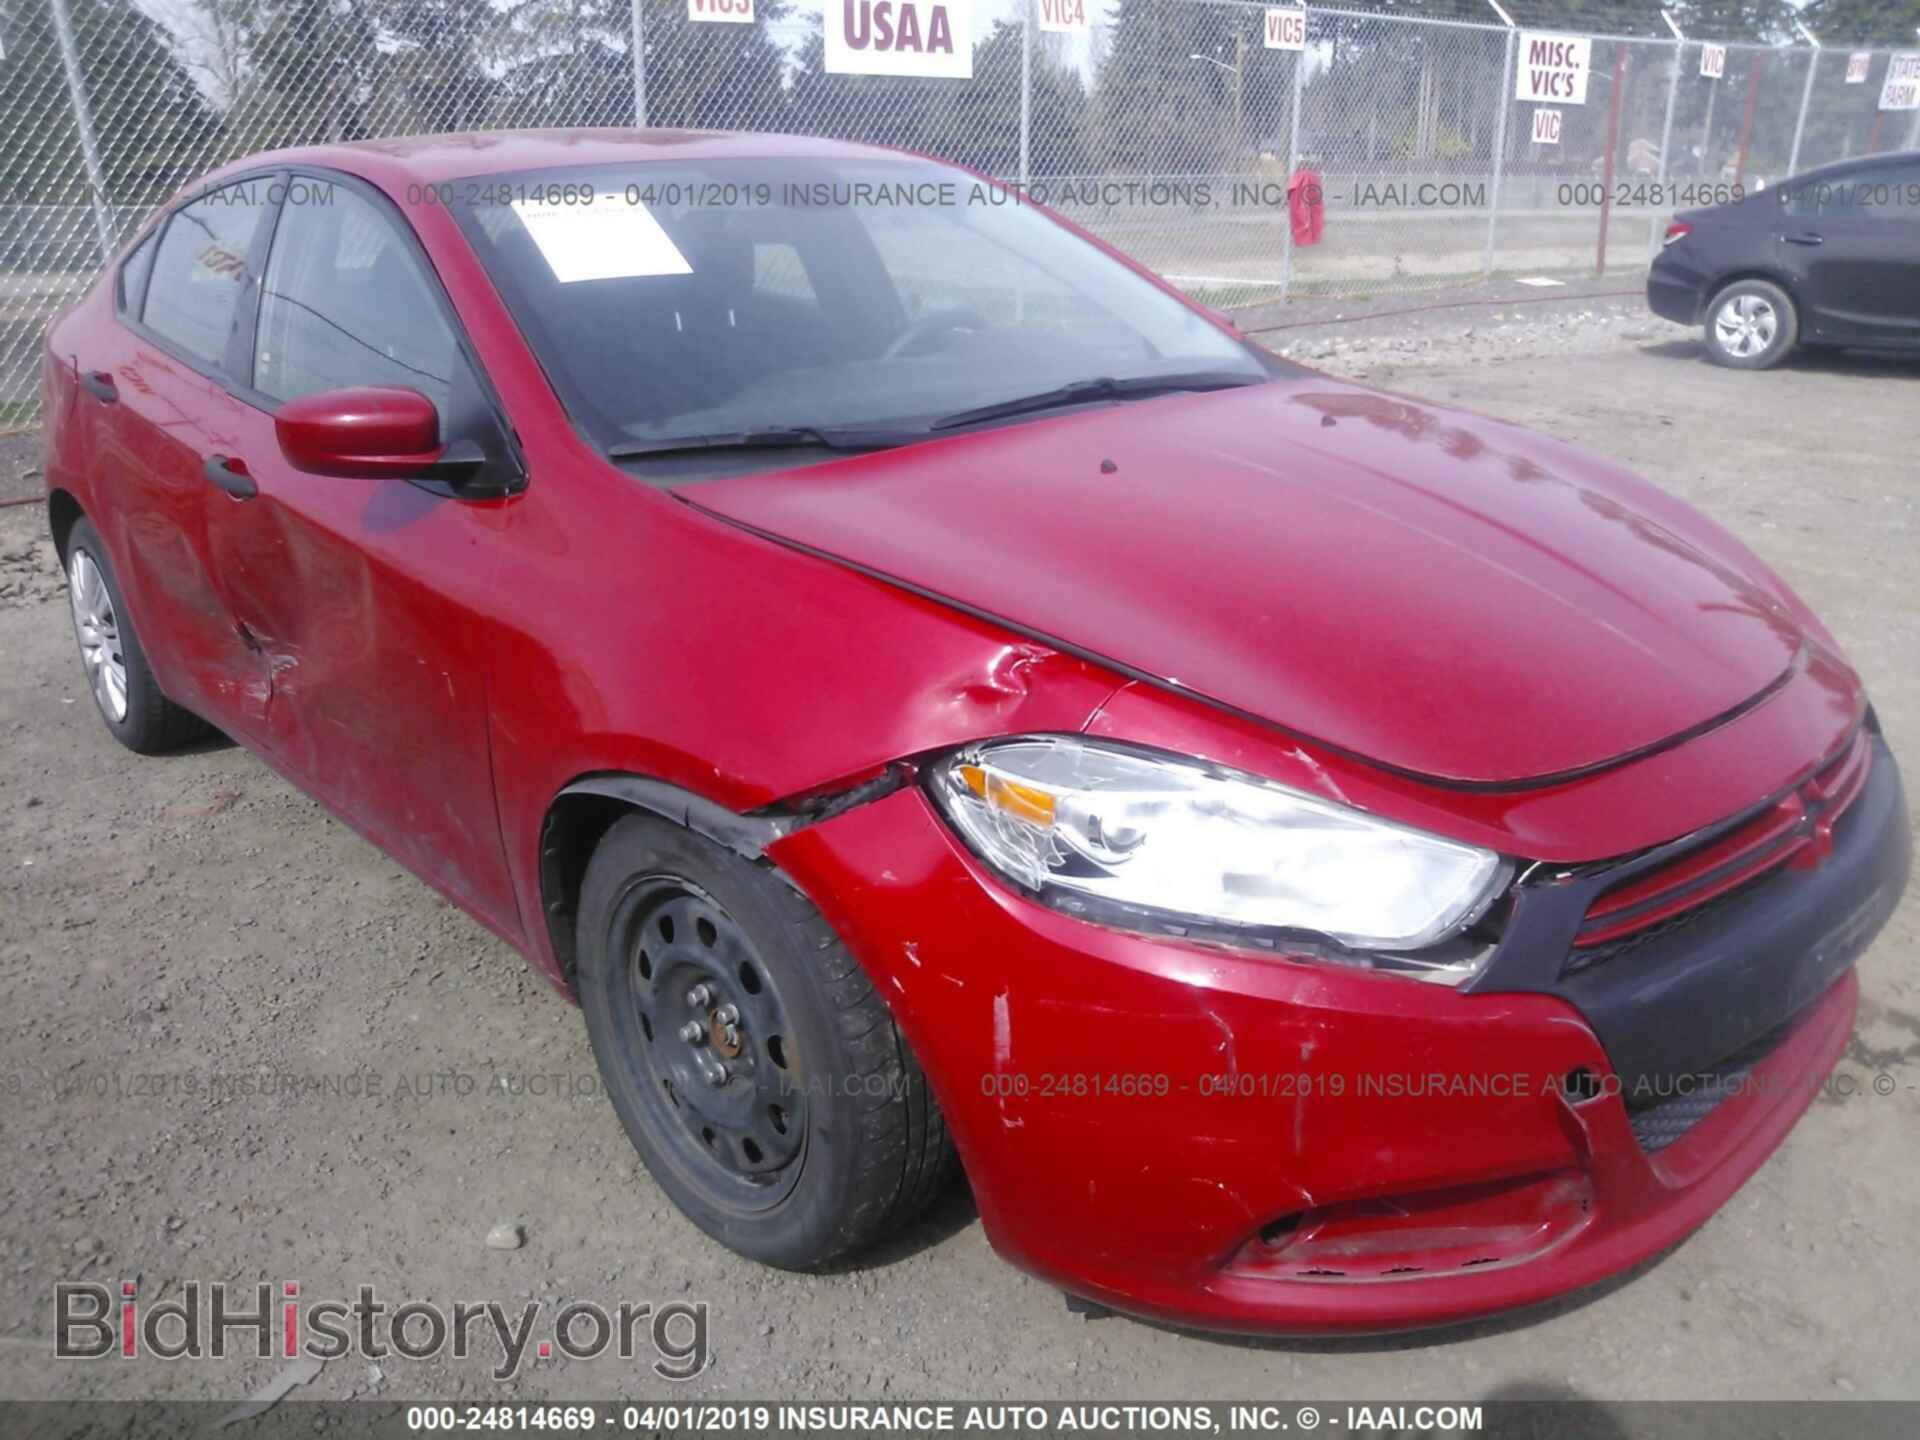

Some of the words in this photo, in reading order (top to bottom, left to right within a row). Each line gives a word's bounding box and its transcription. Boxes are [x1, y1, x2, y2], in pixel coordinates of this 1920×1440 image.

[1042, 0, 1086, 25] VIC4
[843, 0, 954, 54] USAA
[1268, 15, 1303, 44] VIC5
[1529, 40, 1580, 69] MISC.
[1531, 70, 1574, 98] VIC'S
[1536, 112, 1559, 139] VIC
